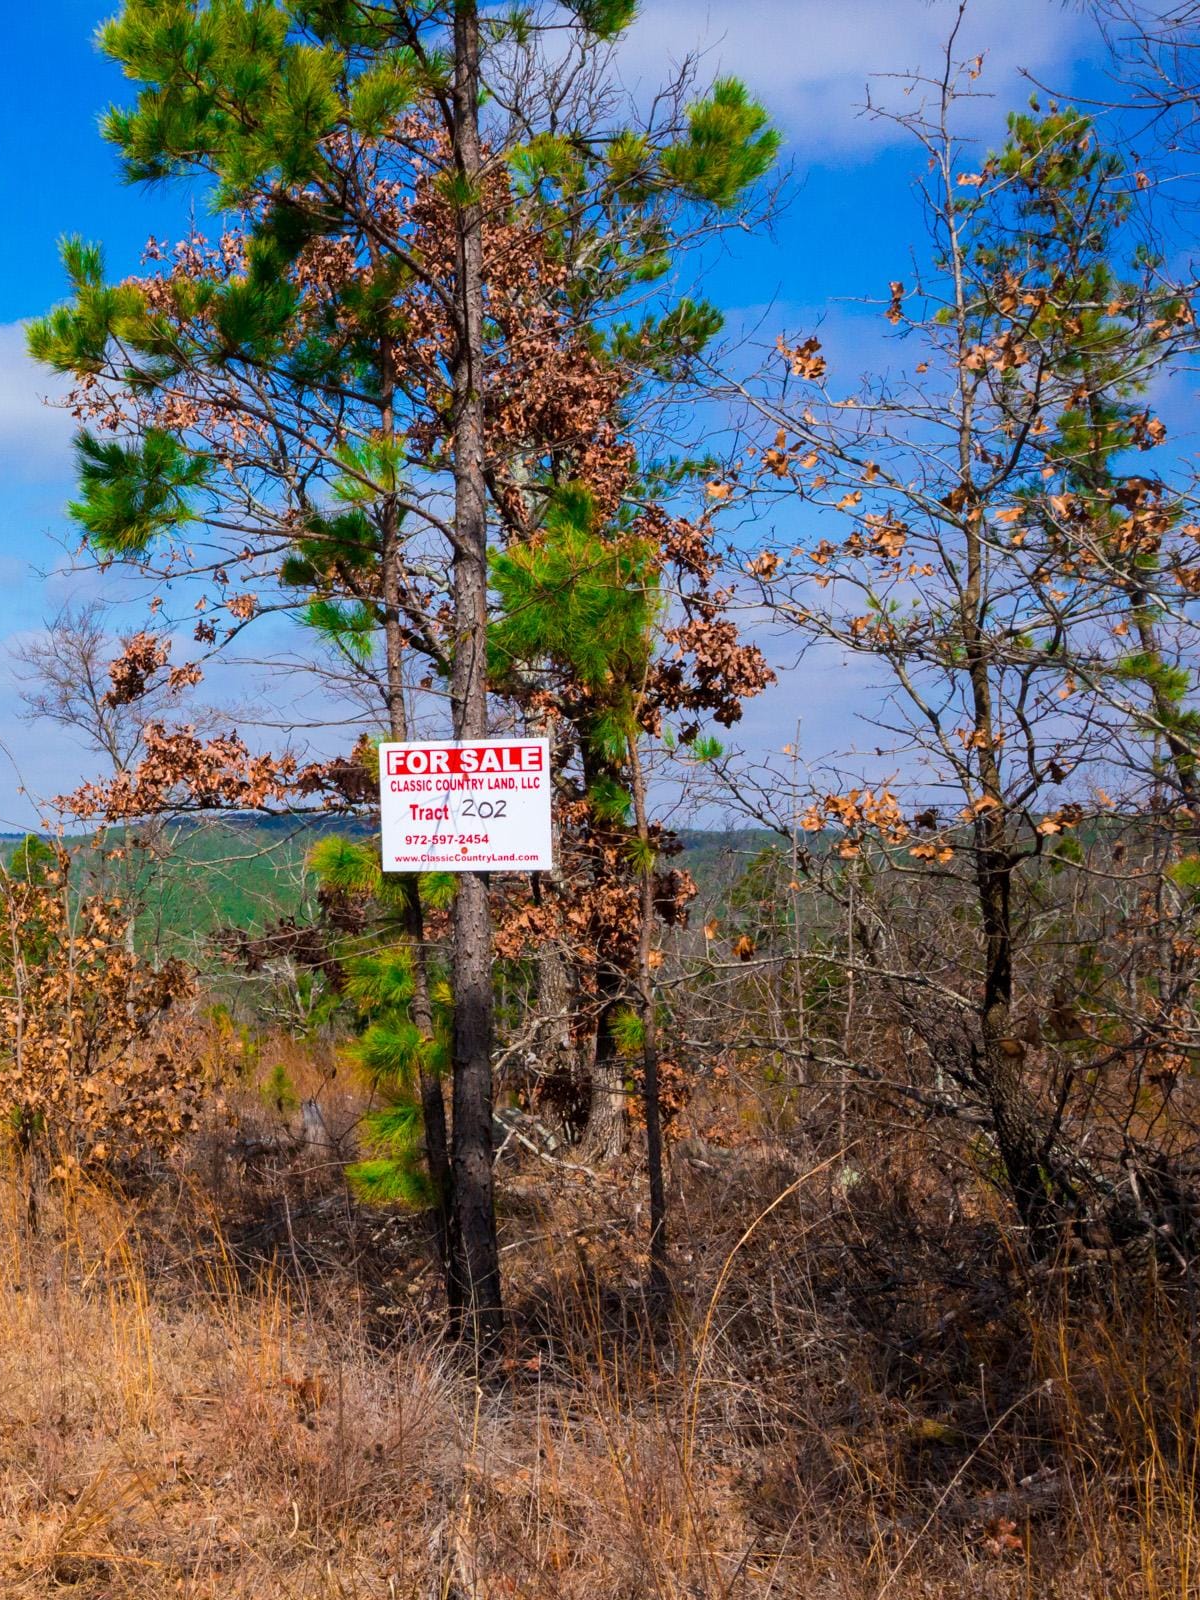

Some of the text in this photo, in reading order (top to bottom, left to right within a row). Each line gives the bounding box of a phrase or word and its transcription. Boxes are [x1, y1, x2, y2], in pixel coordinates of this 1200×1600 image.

[389, 747, 540, 774] FOR SALE
[390, 777, 540, 792] CLASSIC COUNTRY LAND, LLC
[409, 799, 507, 821] Tract 202
[405, 834, 489, 845] 972-597-2454
[394, 853, 539, 863] www.ClassicCountryLand.com
